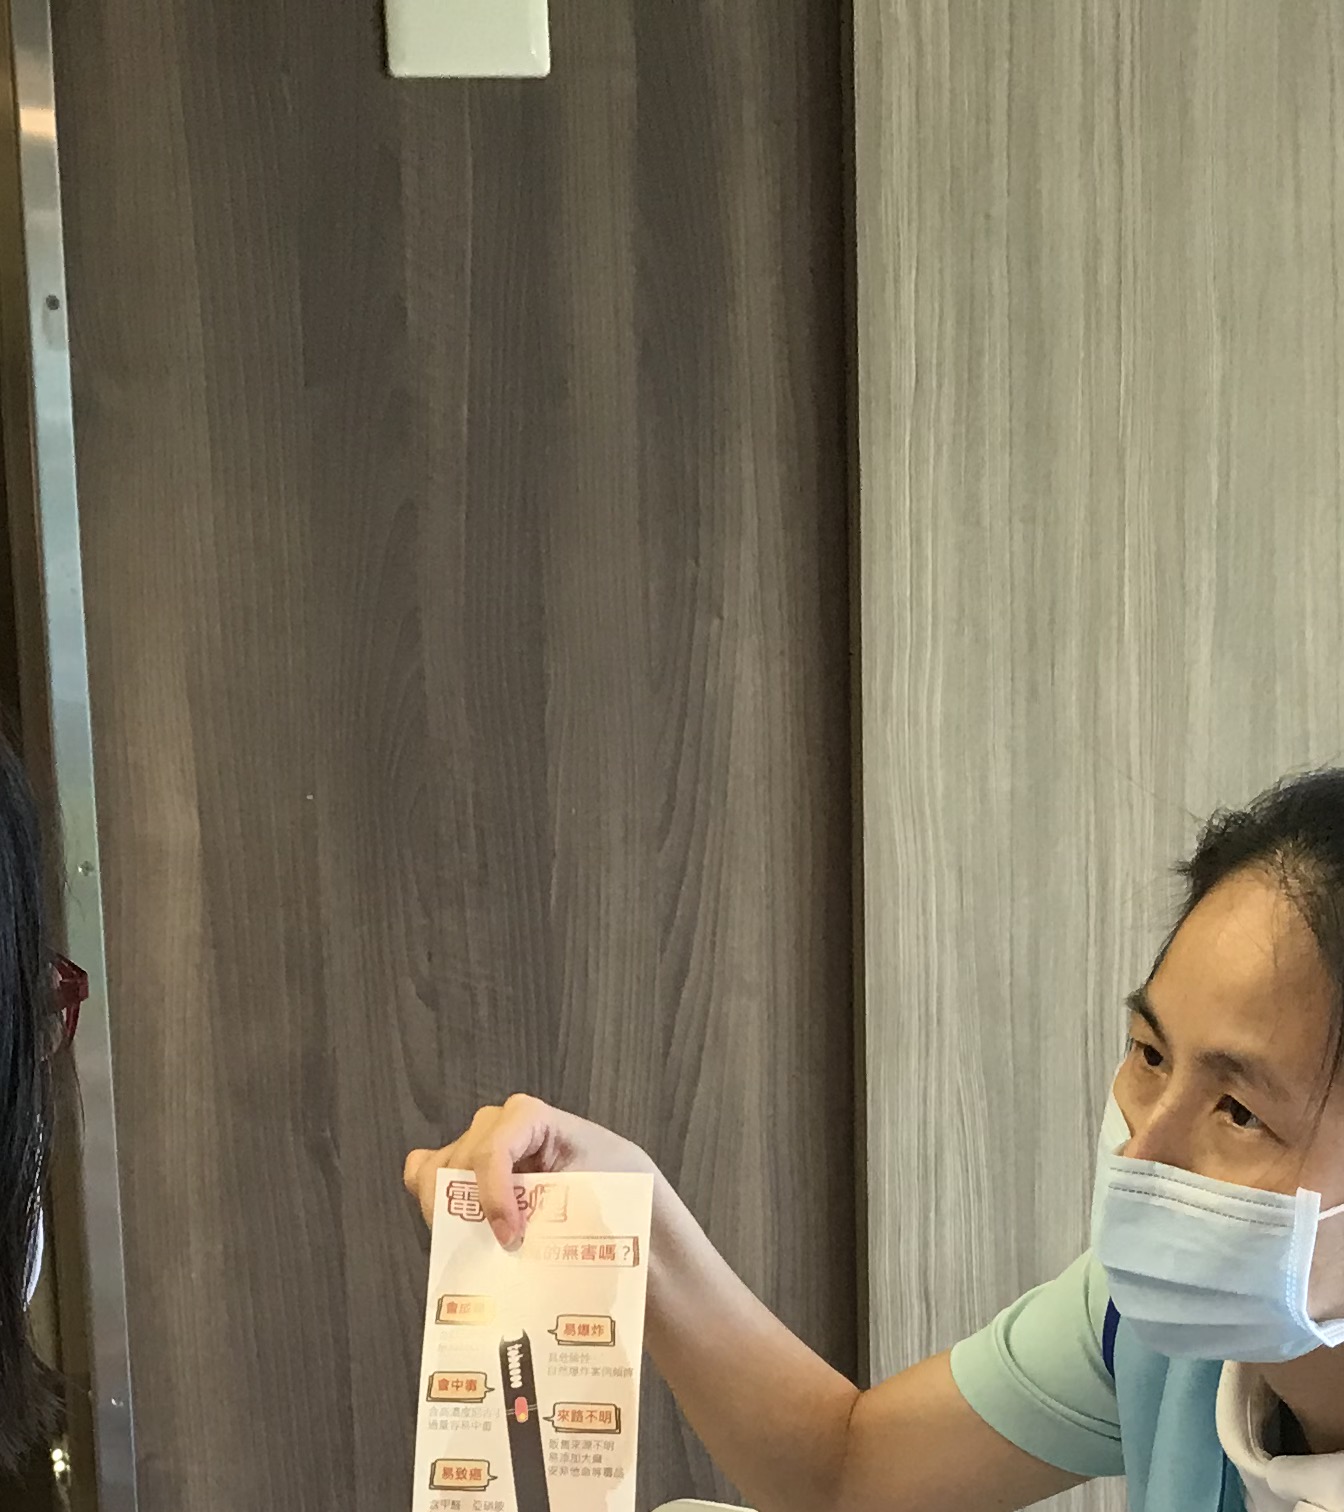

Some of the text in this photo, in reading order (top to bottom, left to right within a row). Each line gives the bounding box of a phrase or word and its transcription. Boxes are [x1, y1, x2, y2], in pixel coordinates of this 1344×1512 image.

[557, 1408, 613, 1425] 來路不明
[441, 1466, 483, 1481] 易致癌
